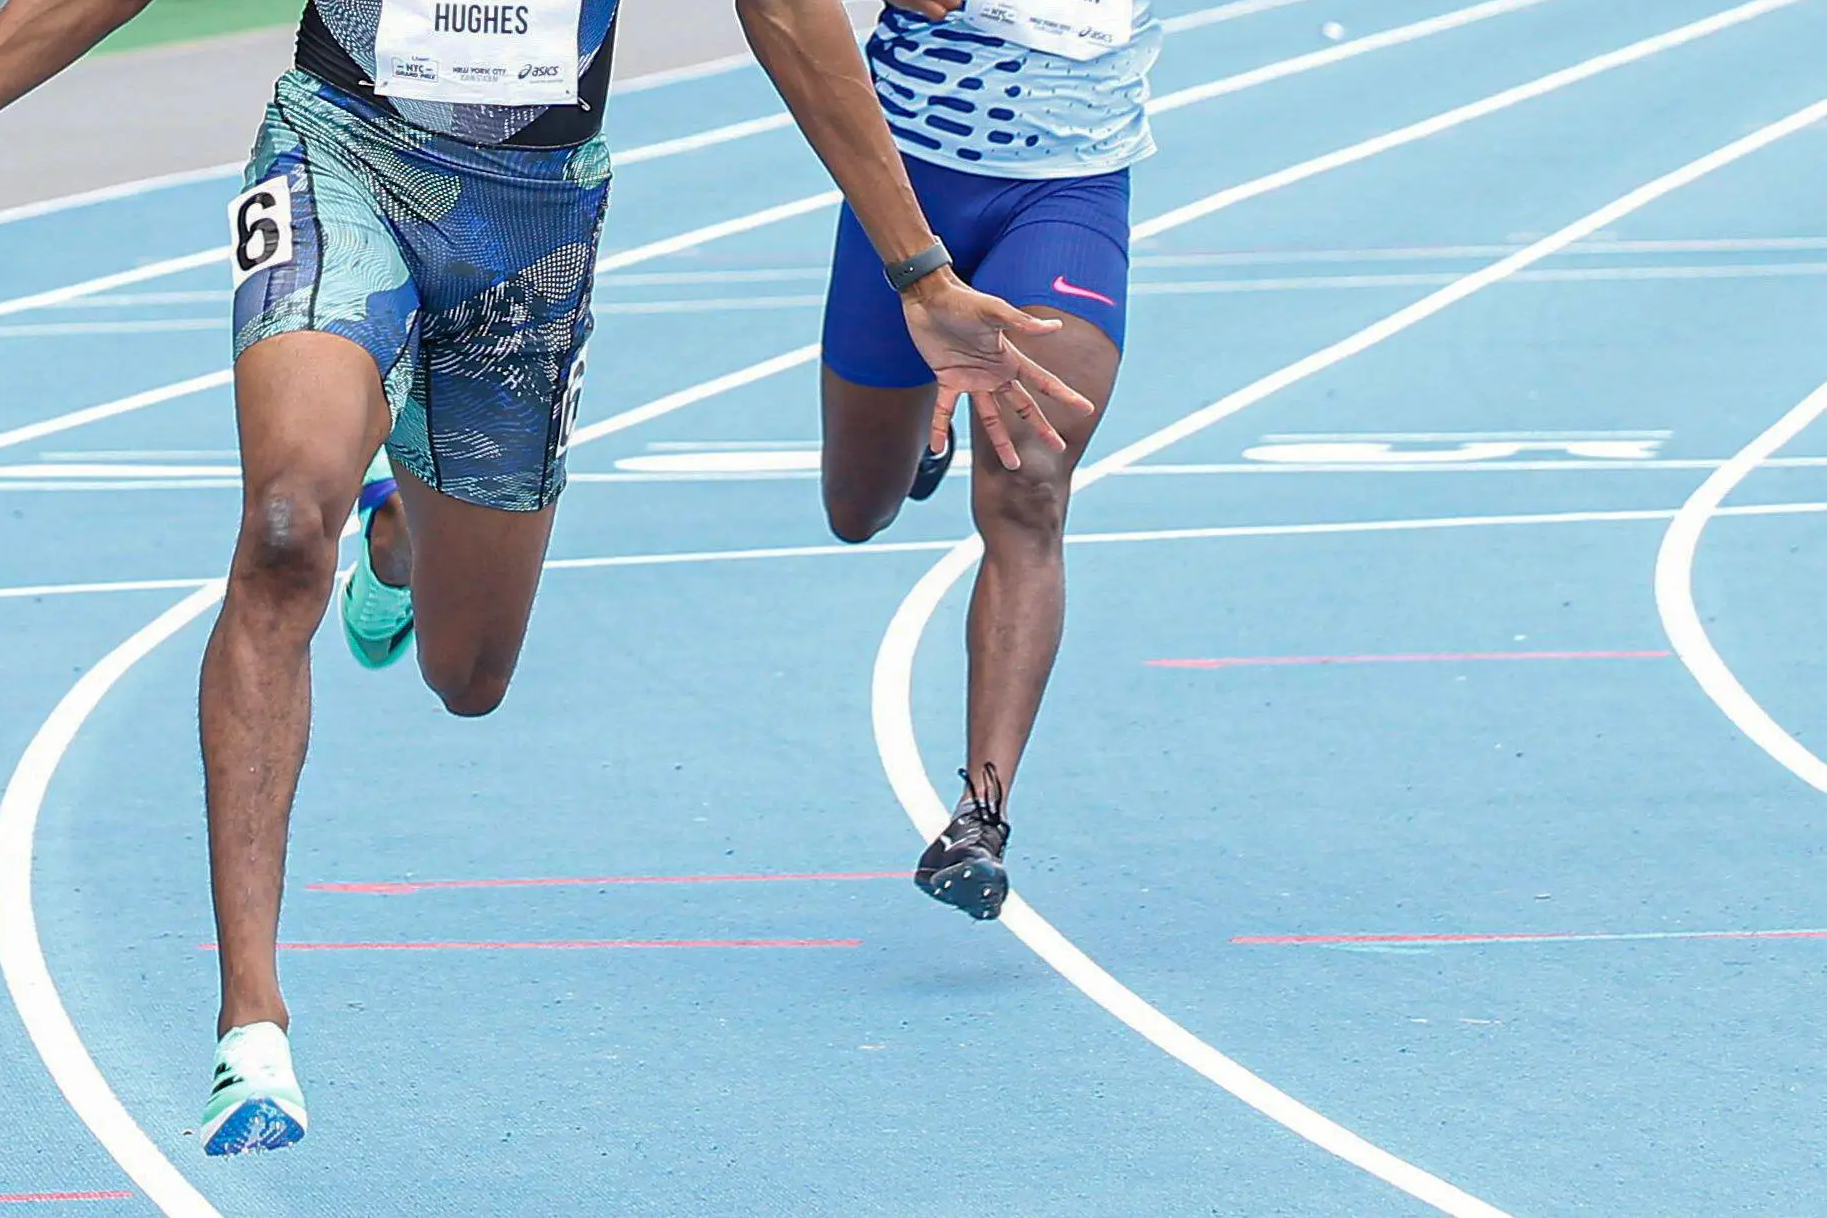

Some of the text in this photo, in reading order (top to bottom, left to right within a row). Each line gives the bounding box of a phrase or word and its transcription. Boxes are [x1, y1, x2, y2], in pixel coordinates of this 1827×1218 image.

[434, 3, 529, 35] HUGHES
[532, 65, 559, 77] asics
[237, 192, 279, 271] 6
